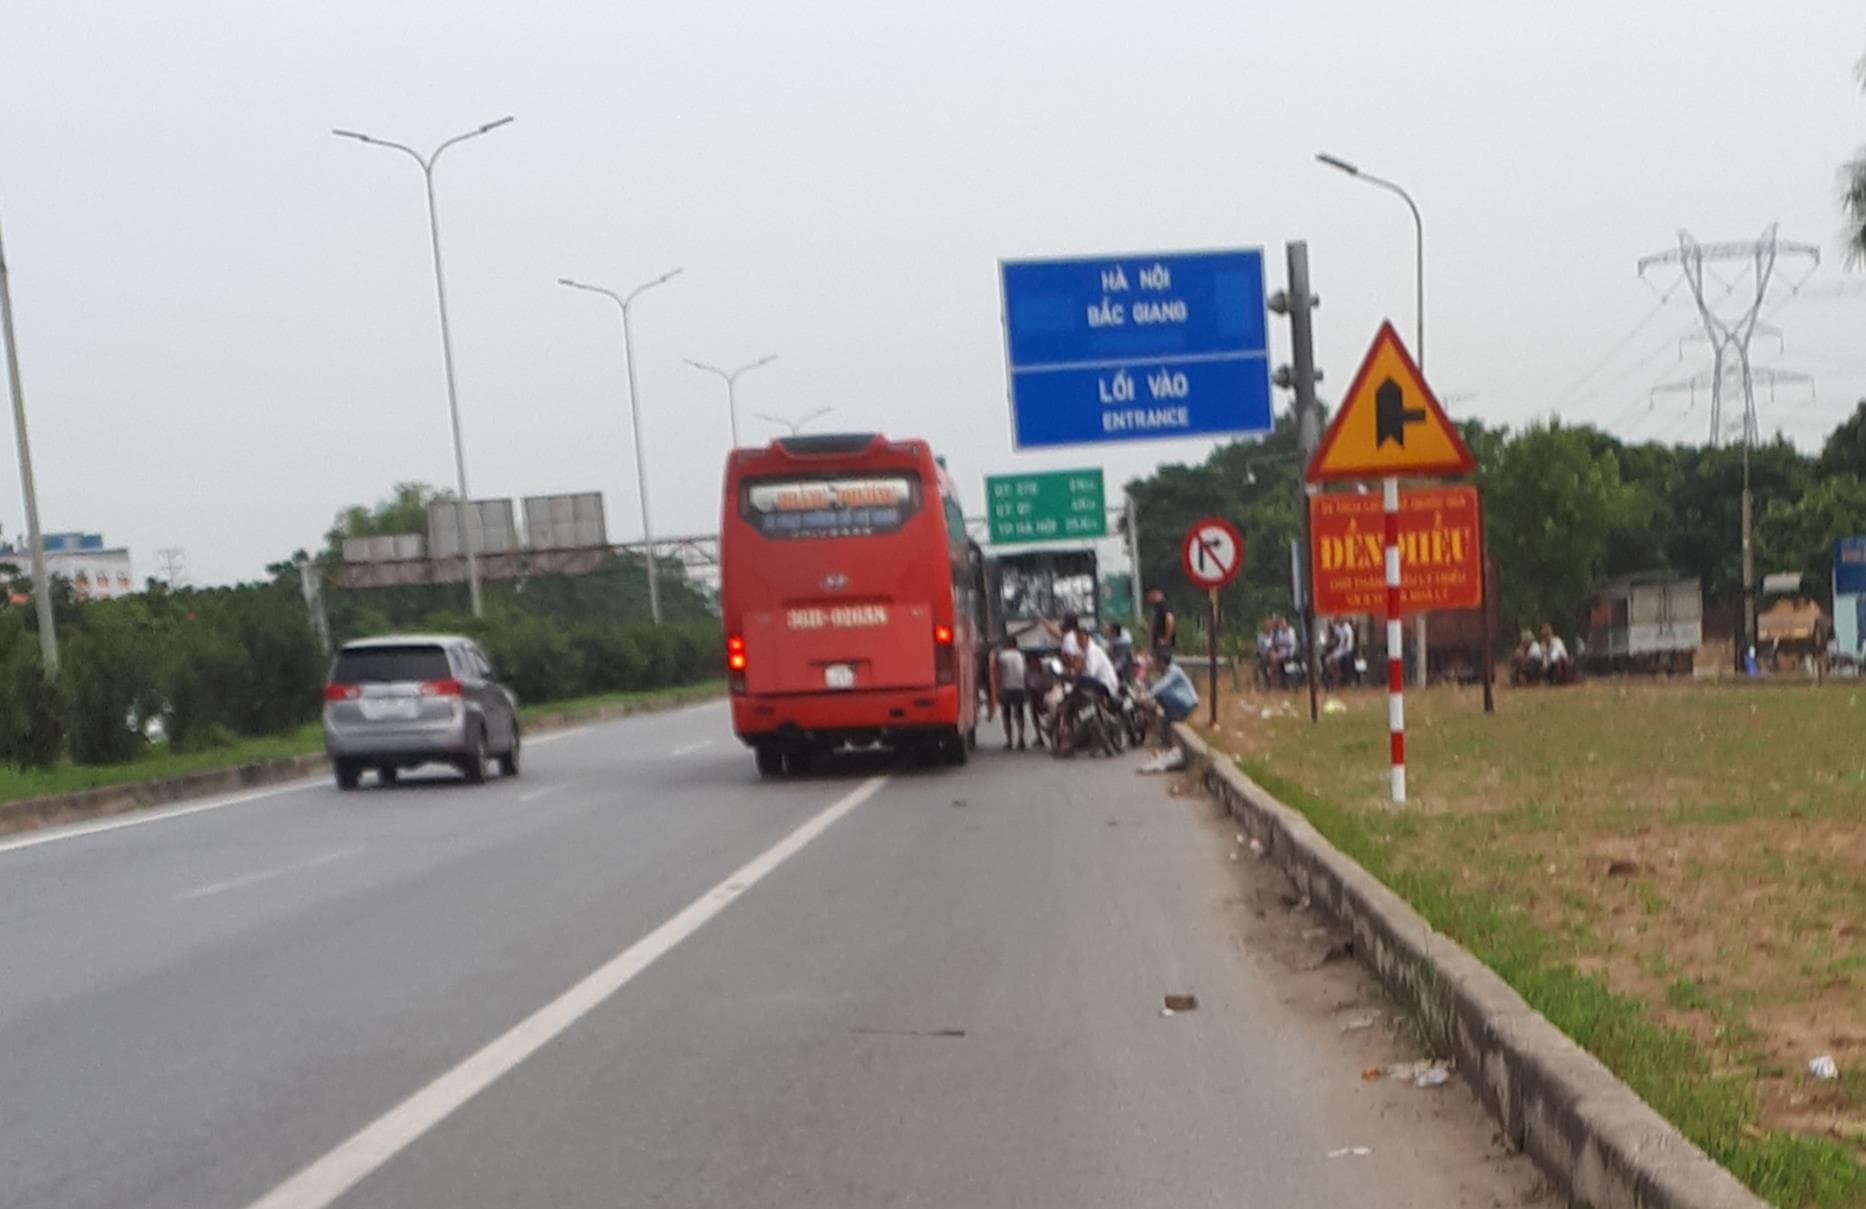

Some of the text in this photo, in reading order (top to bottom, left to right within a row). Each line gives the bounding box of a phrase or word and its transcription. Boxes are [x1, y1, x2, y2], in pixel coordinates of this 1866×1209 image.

[1101, 261, 1171, 292] HÀ NỘI
[1087, 296, 1188, 328] BẮC GIANG
[1099, 366, 1190, 403] LỐI VÀO
[1102, 407, 1190, 432] ENTRANCE
